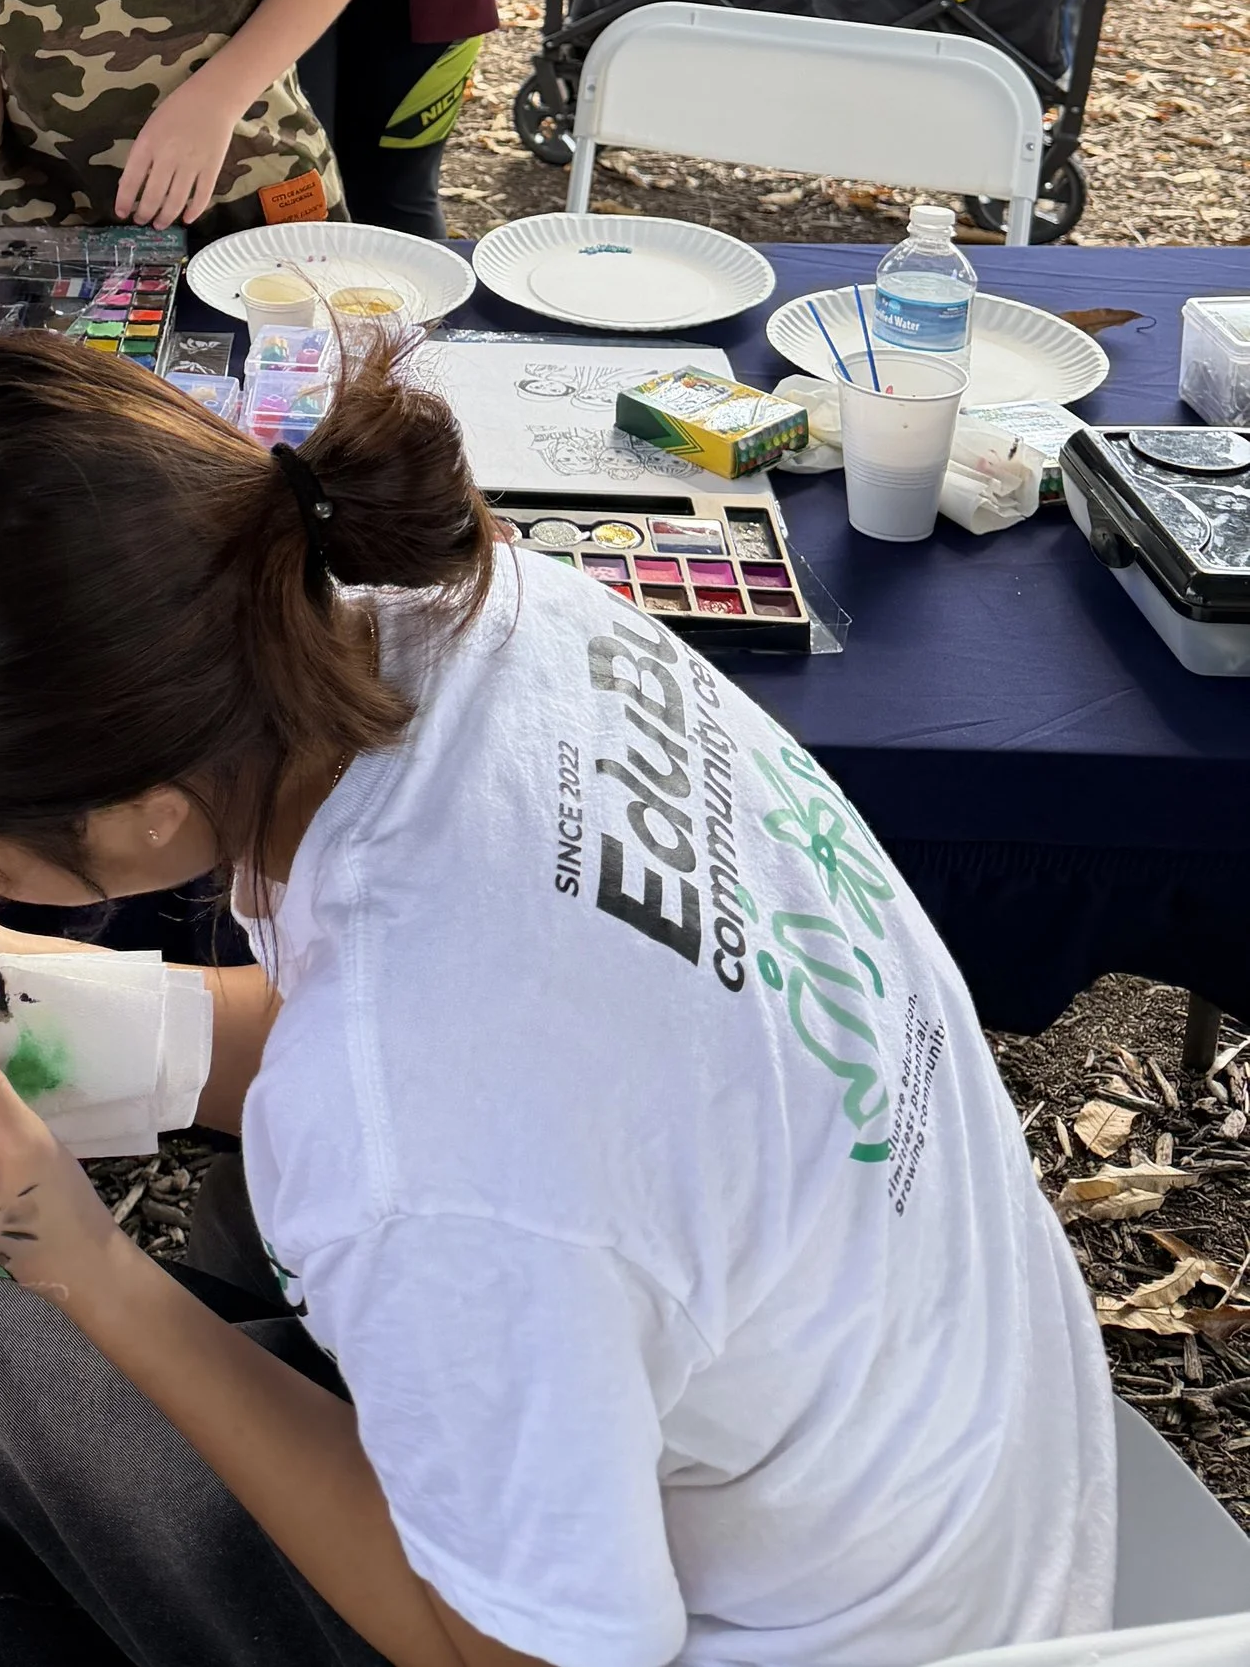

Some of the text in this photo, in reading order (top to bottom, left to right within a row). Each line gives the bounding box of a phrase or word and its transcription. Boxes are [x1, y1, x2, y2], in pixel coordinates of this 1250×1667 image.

[893, 315, 920, 332] Water
[554, 739, 583, 898] SINCE 2022
[688, 703, 747, 993] community
[895, 1130, 925, 1218] growing
